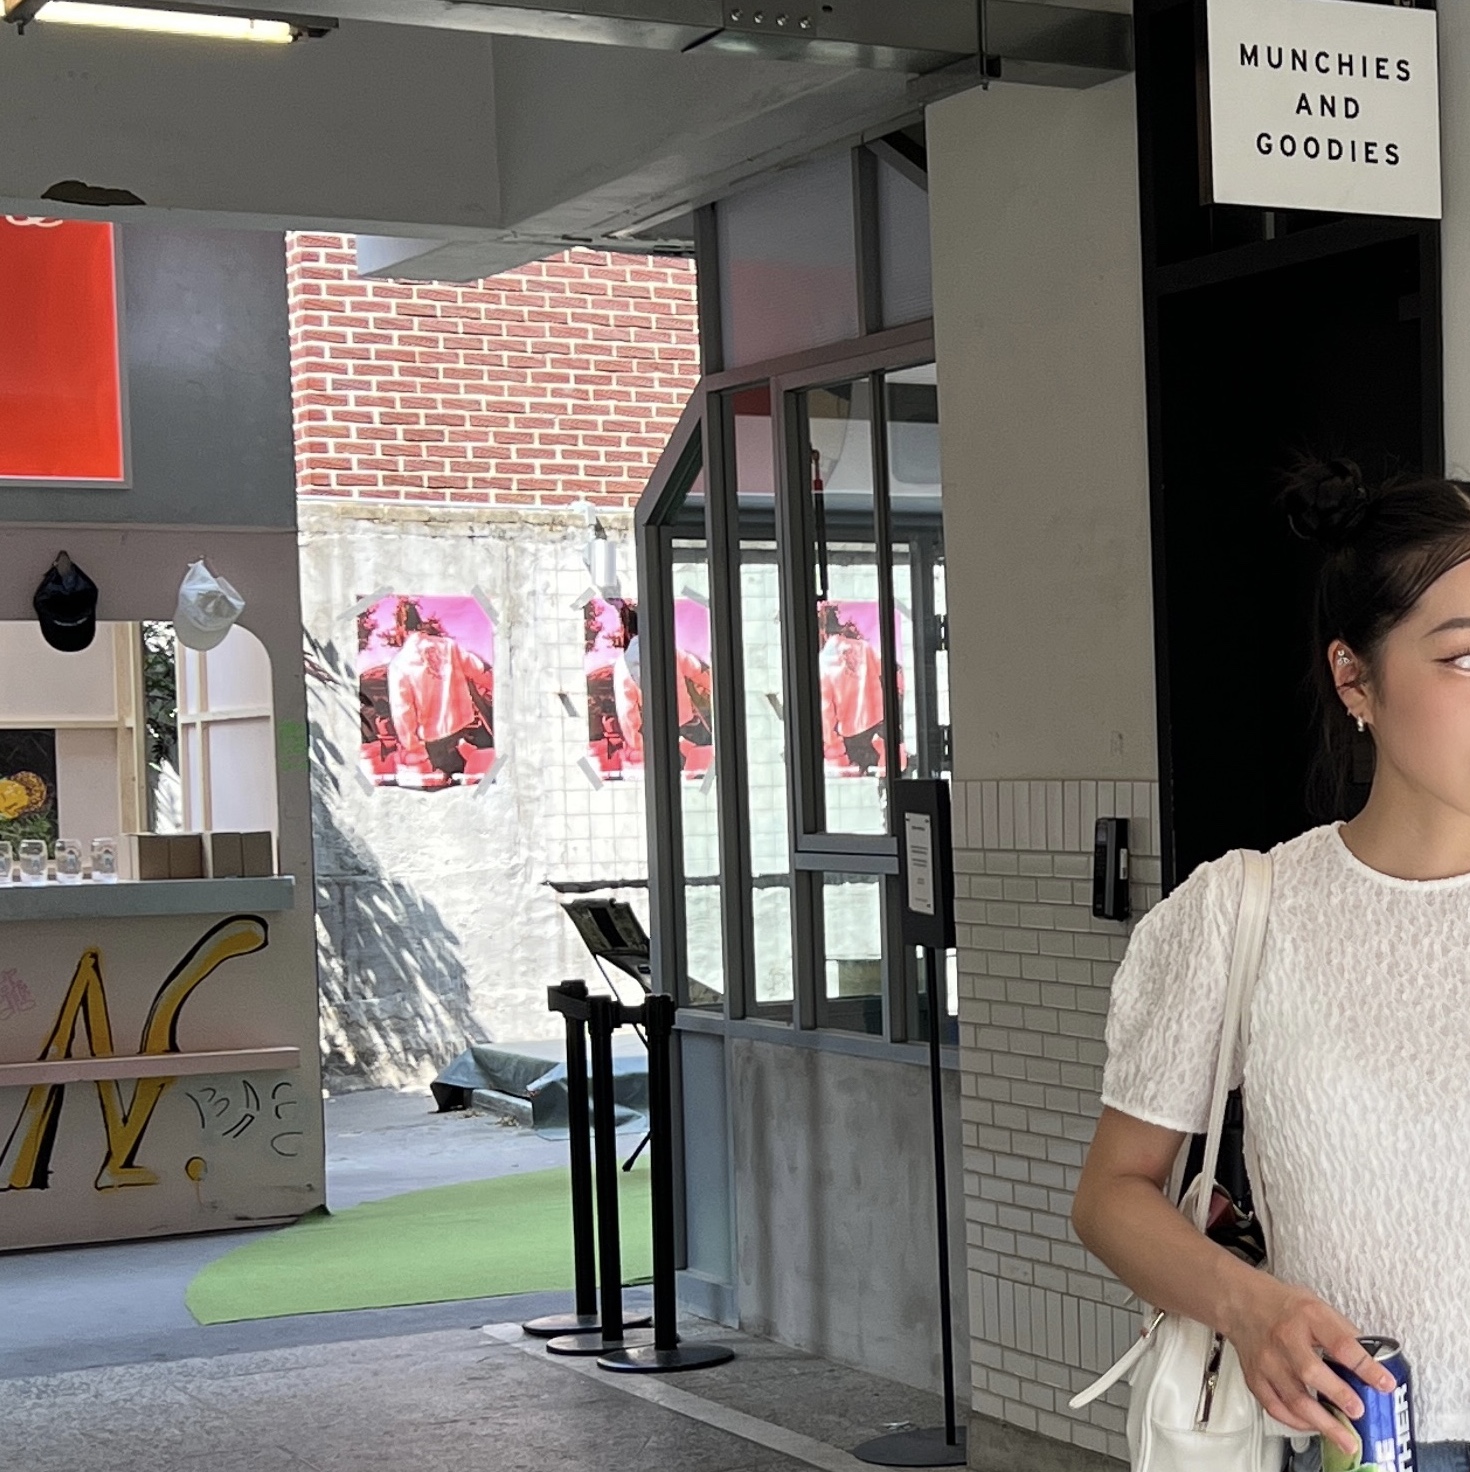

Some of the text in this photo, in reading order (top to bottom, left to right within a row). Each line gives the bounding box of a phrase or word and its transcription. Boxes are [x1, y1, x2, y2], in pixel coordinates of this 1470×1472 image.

[1240, 43, 1411, 81] MUNCHIES
[1295, 92, 1360, 119] AND
[1256, 132, 1400, 166] GOODIES
